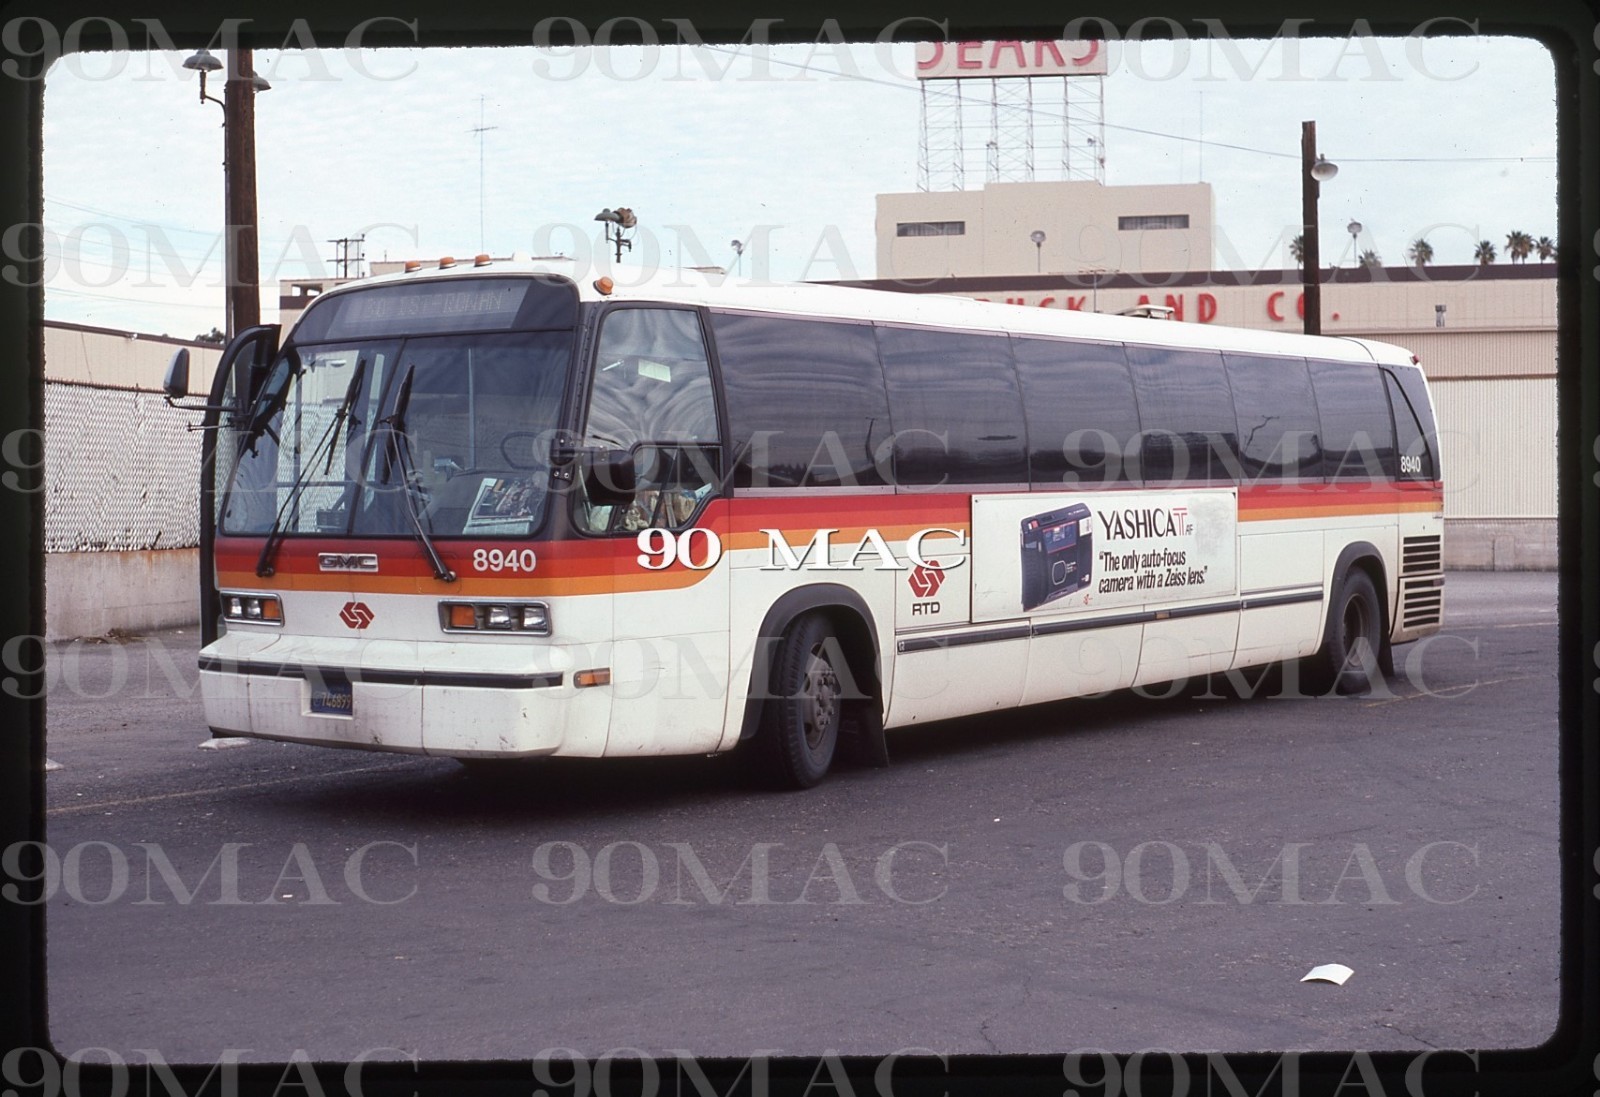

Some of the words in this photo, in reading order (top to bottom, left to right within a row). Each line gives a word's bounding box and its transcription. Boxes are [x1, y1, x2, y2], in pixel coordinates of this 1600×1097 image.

[1400, 455, 1421, 473] 8940
[1097, 508, 1177, 540] YASHICA
[318, 554, 378, 570] GMC
[472, 548, 537, 573] 8940
[1121, 549, 1141, 574] only
[1141, 548, 1186, 569] auto-focus
[1098, 574, 1134, 594] camera
[1136, 569, 1156, 590] with
[1157, 573, 1164, 588] a
[1164, 568, 1187, 587] Zeiss
[912, 602, 941, 616] RTD
